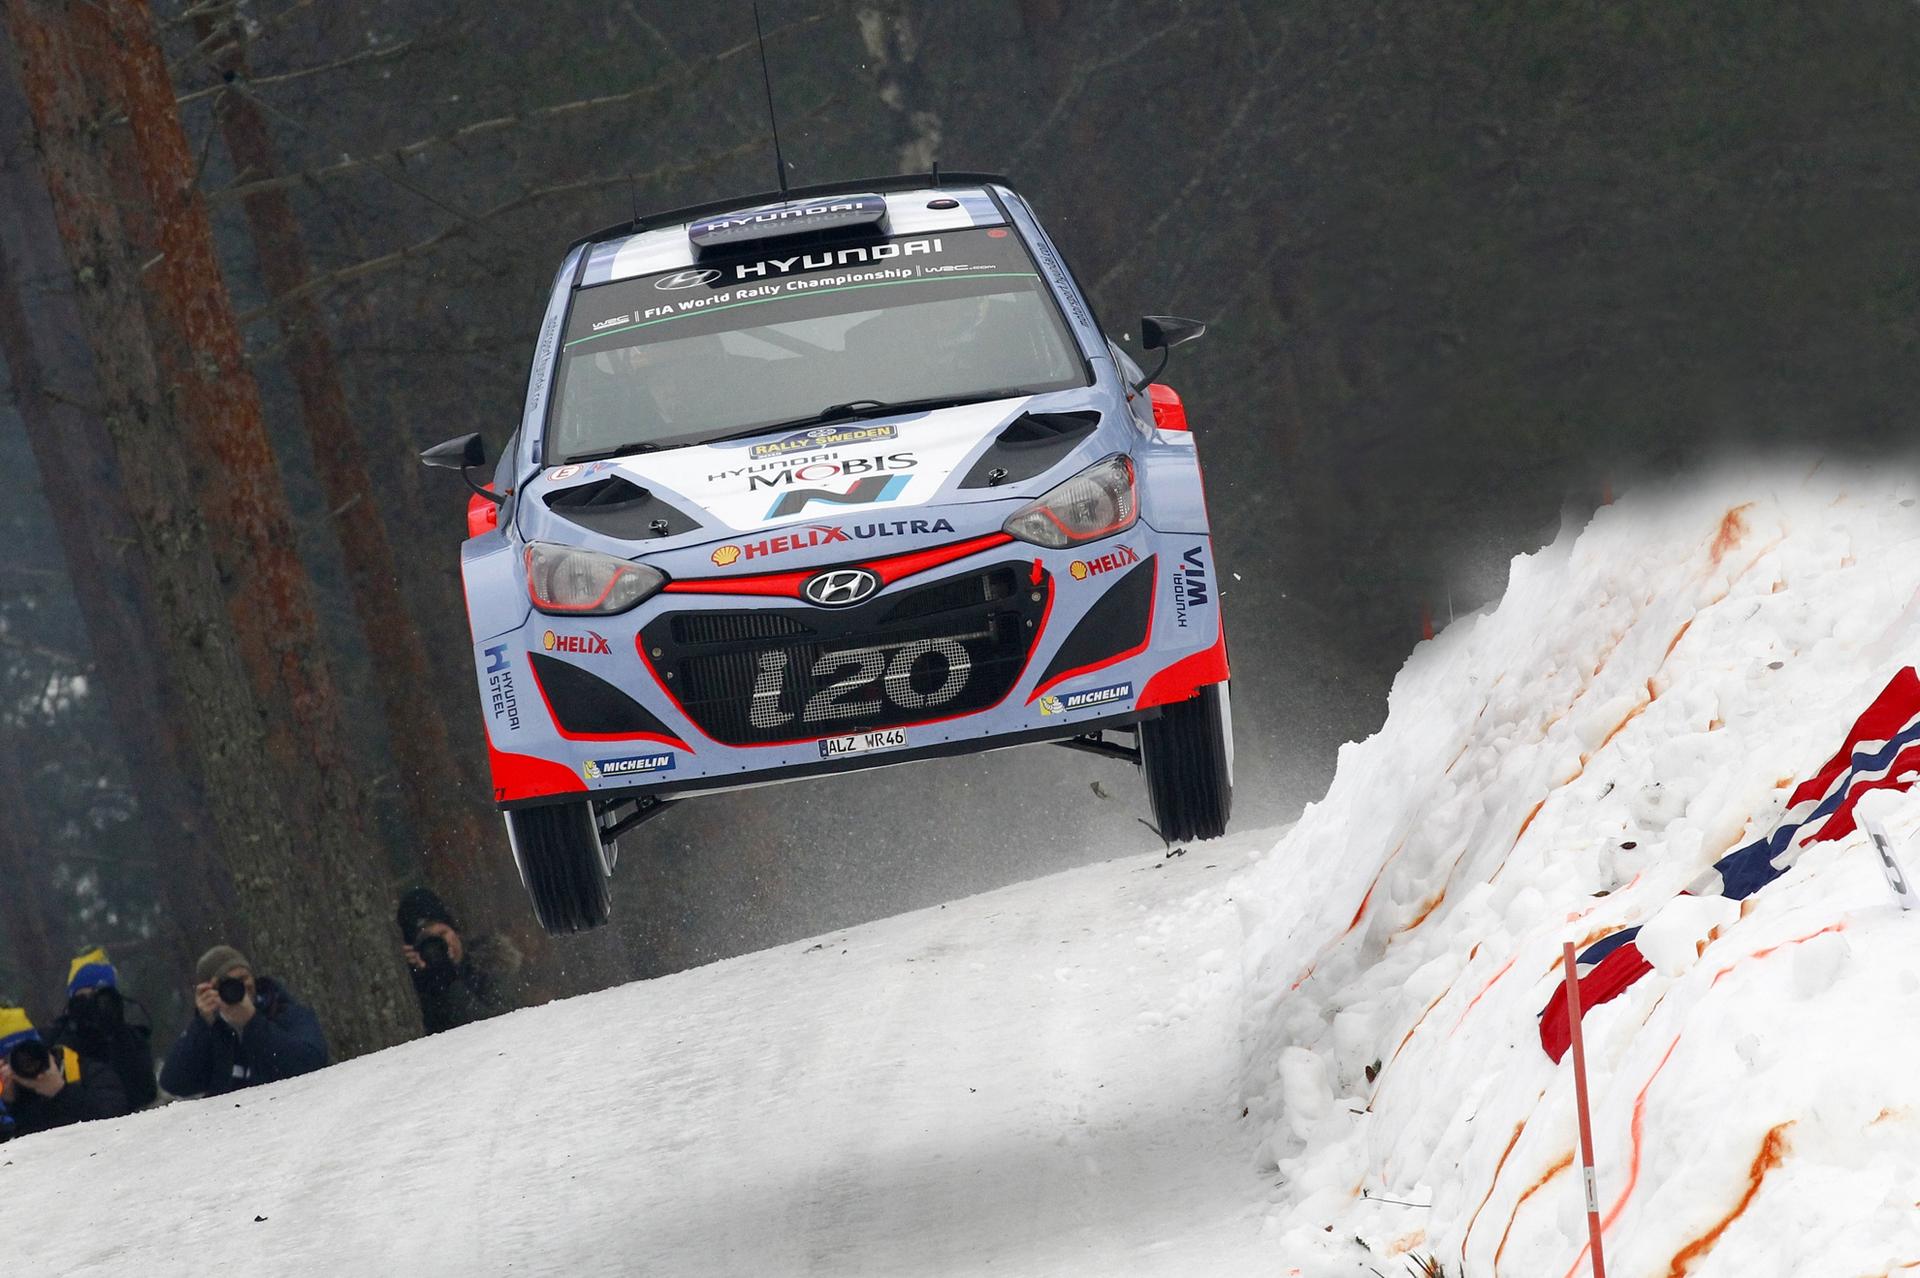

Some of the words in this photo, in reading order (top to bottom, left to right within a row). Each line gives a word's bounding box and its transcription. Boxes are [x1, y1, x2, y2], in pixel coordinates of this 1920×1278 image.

[708, 202, 863, 231] HYUNDAI
[736, 238, 943, 279] HYUNDAI
[644, 304, 674, 320] FIA
[678, 292, 731, 312] World
[736, 283, 781, 301] Rally
[786, 266, 913, 292] Championship
[756, 439, 810, 455] RALLY
[815, 427, 891, 446] SWEDEN
[708, 452, 839, 482] HYUNDAI
[748, 452, 918, 491] MOBIS
[744, 526, 848, 561] HELIX
[854, 518, 956, 540] ULTRA
[1086, 545, 1139, 577] HELIX
[1173, 573, 1188, 627] HYUNDAI
[556, 630, 612, 655] HELIX
[489, 676, 505, 719] STEEL
[501, 671, 521, 731] HYUNDAI
[1067, 685, 1129, 707] MICHELIN
[829, 736, 856, 754] ALZ
[603, 756, 670, 773] MICHELIN
